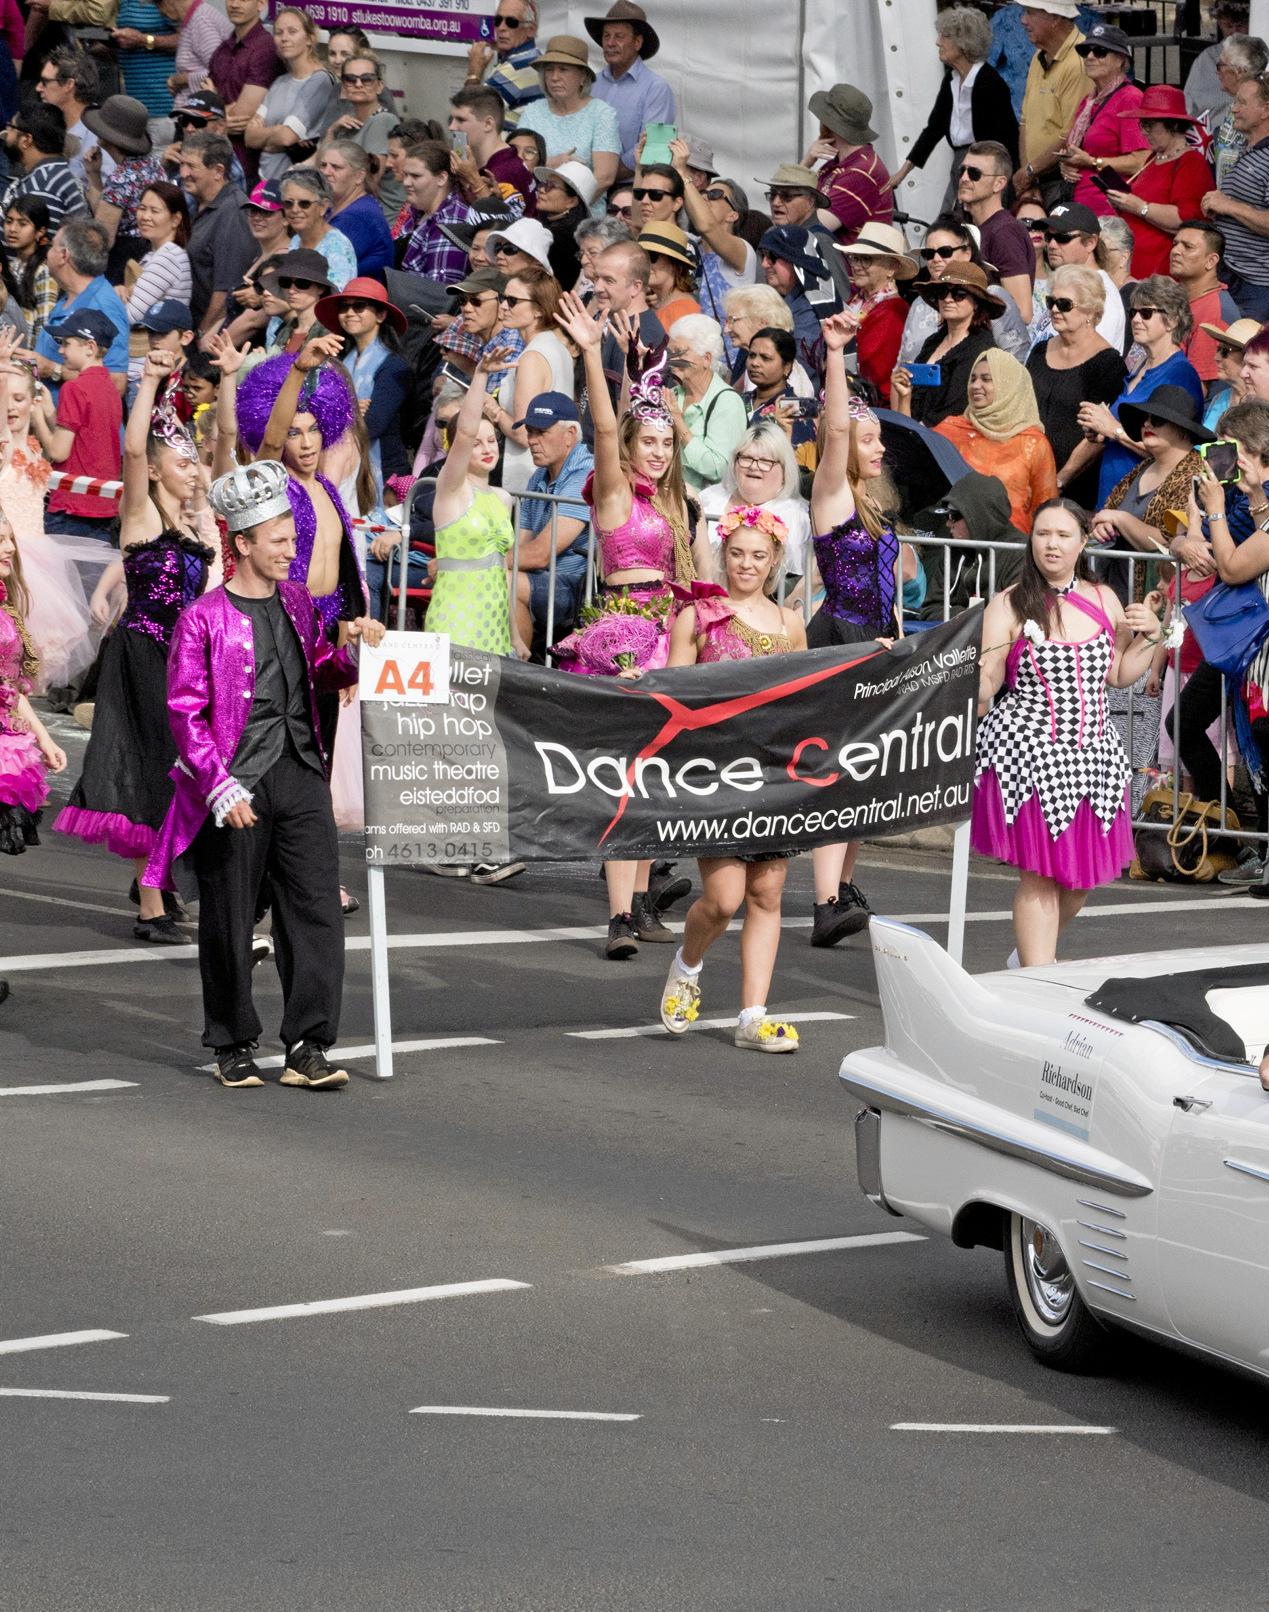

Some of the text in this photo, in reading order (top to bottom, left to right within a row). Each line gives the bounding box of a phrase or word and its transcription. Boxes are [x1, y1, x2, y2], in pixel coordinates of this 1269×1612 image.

[455, 0, 470, 10] 910
[327, 6, 348, 23] 1910
[351, 9, 461, 34] stlukestoowoomba.org.au
[449, 648, 492, 662] lassical
[374, 659, 434, 696] A4
[449, 661, 493, 685] llet
[853, 645, 977, 699] Principal Alison Vallette
[920, 670, 951, 688] MSFD
[397, 712, 493, 740] hip hop
[371, 740, 496, 759] contemporary
[534, 697, 974, 799] Dance Central
[370, 761, 500, 780] music theatre
[399, 786, 500, 805] eisteddfod
[435, 803, 500, 816] preparation
[656, 782, 970, 842] www.dancecentral.net.au
[388, 823, 427, 834] offered
[428, 822, 448, 834] with
[450, 822, 471, 833] RAD
[473, 823, 481, 833] &
[483, 822, 500, 833] SFD
[365, 842, 493, 859] ph 4613 0415
[1061, 1030, 1094, 1060] Adrian
[1041, 1060, 1093, 1101] Richardson
